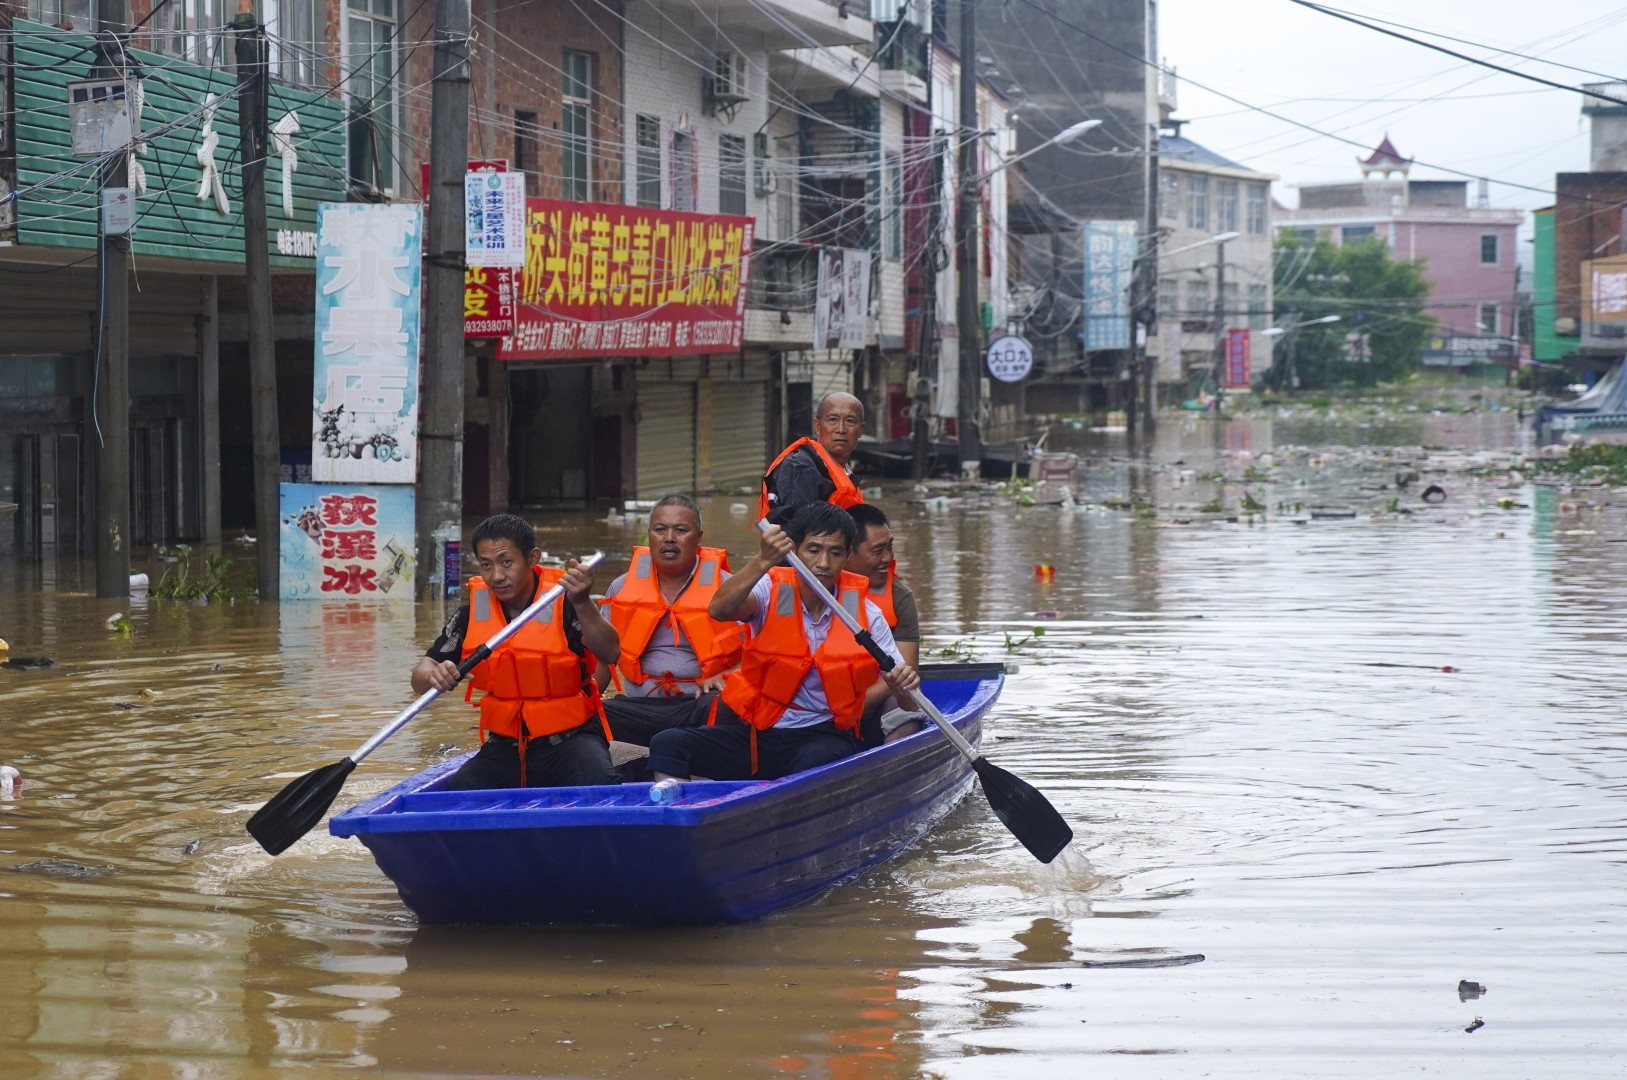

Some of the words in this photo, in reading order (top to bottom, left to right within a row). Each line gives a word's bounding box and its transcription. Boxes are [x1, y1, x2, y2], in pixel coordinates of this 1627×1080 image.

[320, 209, 416, 247] 果天下
[485, 190, 505, 249] 未来之星艺术培训
[322, 251, 412, 414] 水果店
[464, 320, 512, 333] 932938078
